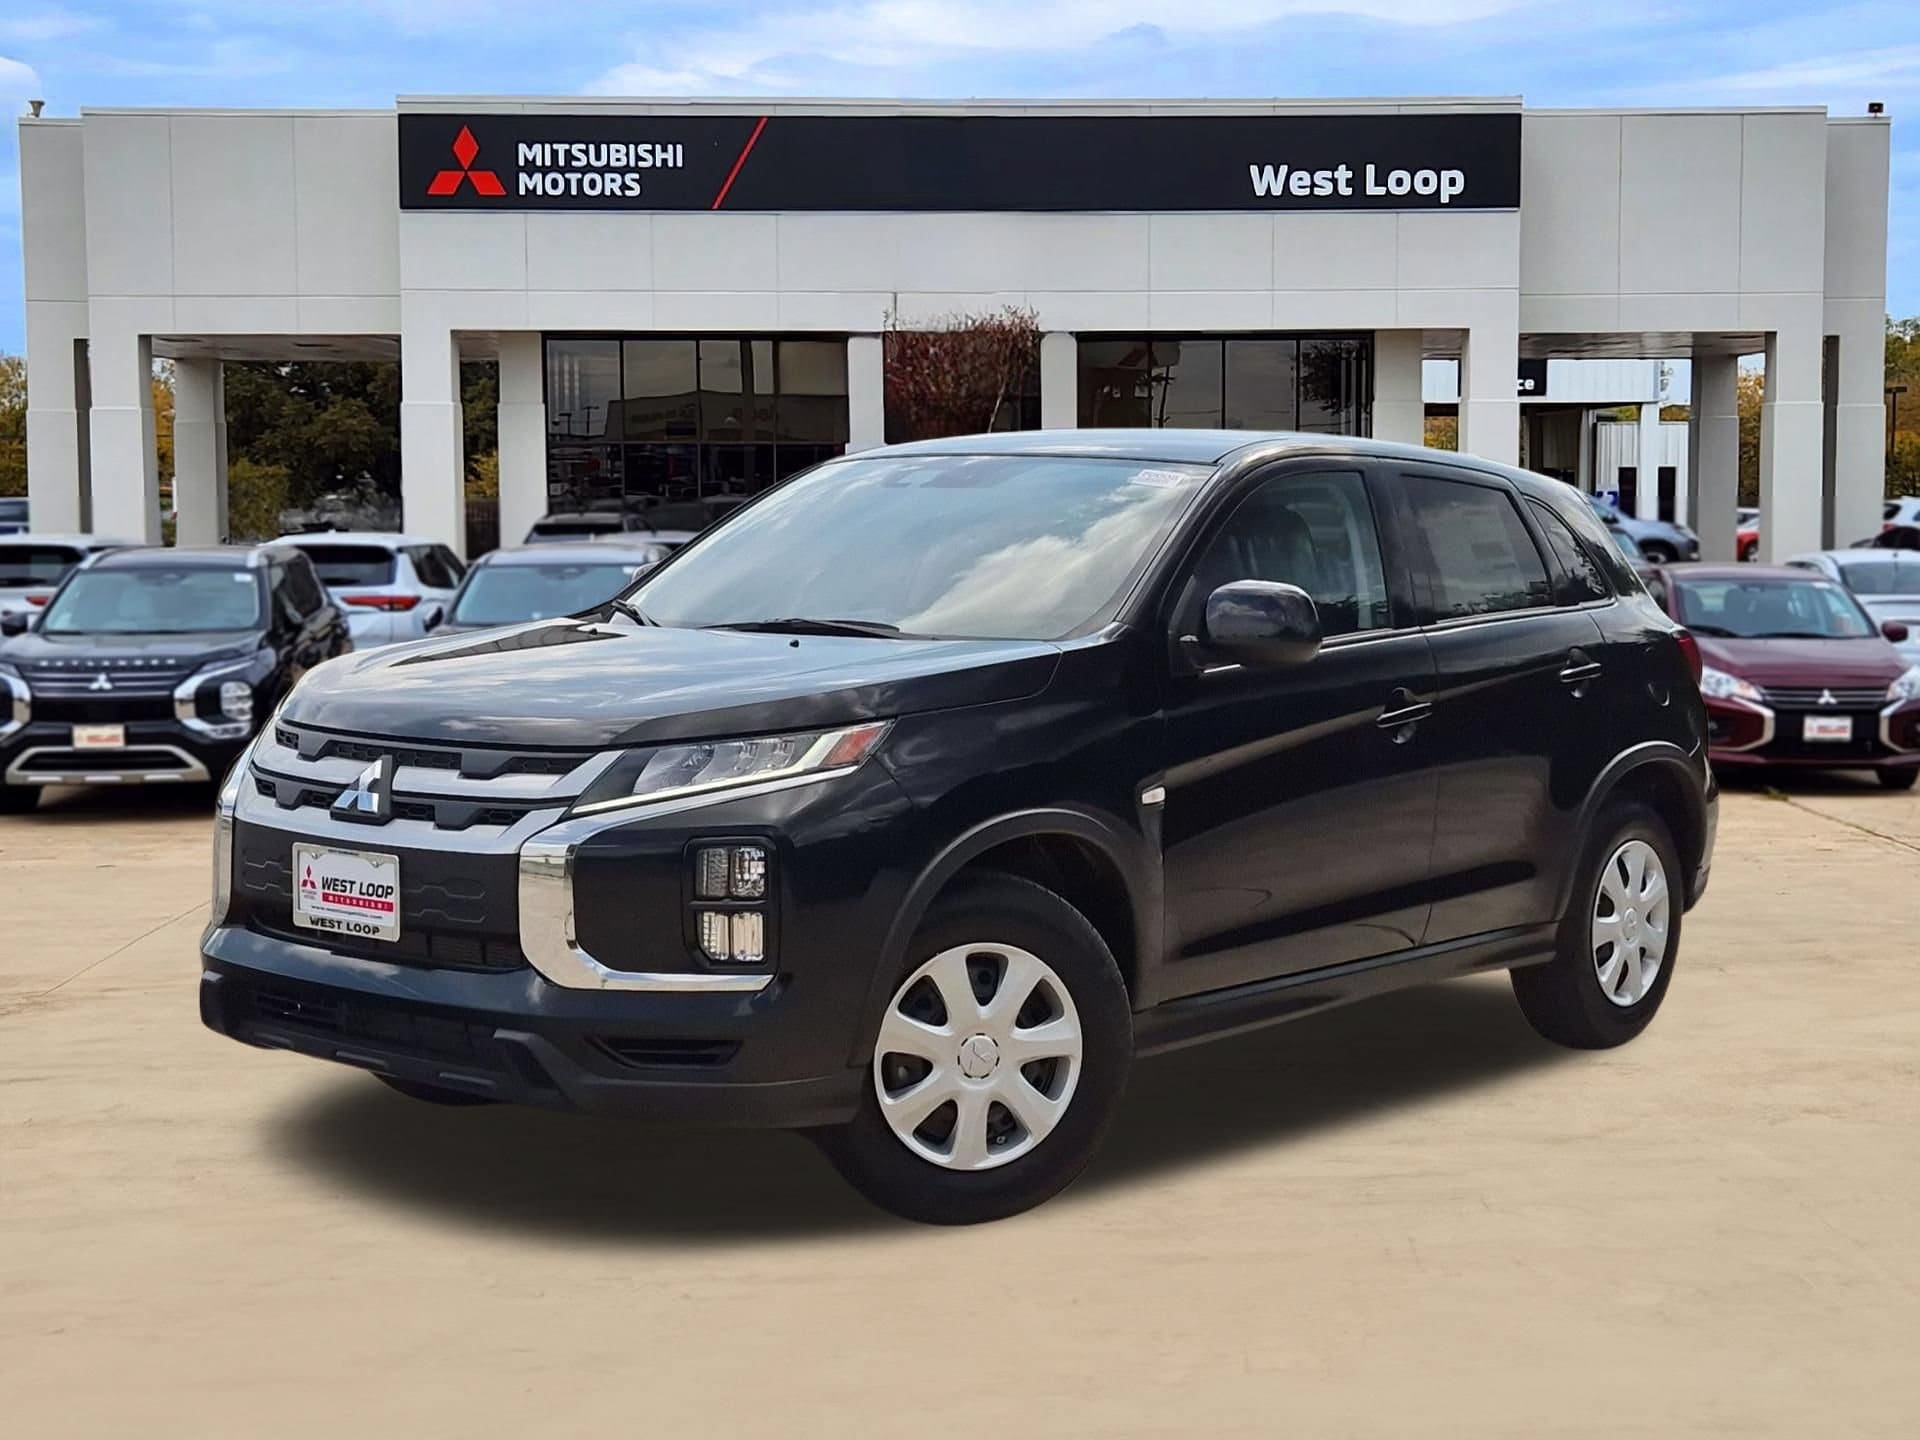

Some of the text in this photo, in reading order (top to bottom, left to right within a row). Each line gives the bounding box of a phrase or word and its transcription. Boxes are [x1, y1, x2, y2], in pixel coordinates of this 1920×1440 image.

[518, 143, 683, 168] MITSUBISHI
[518, 172, 641, 196] MOTORS
[1249, 164, 1465, 203] West Loop
[321, 875, 394, 900] WEST LOOP
[309, 915, 380, 936] WEST LOOP
